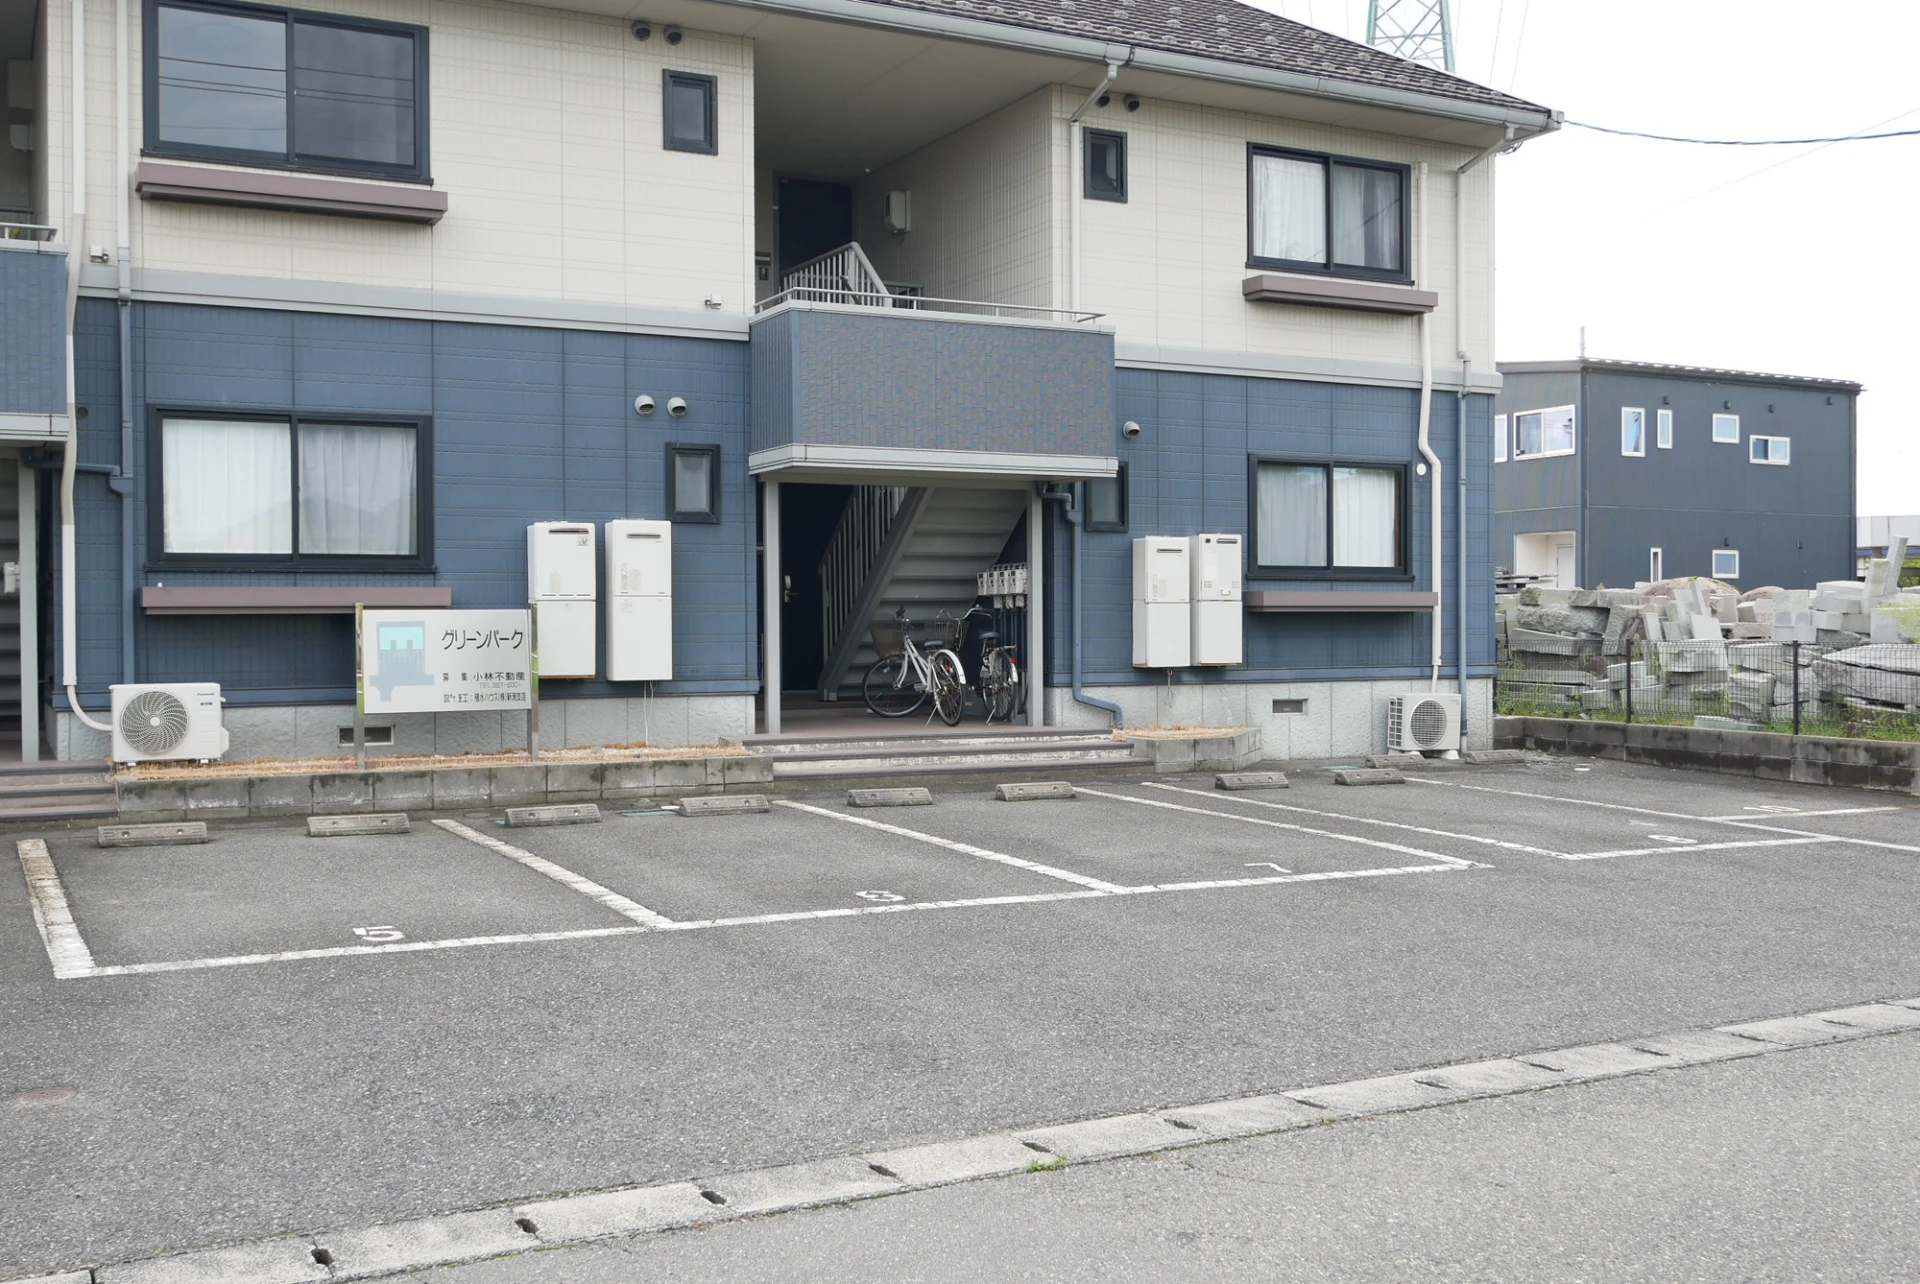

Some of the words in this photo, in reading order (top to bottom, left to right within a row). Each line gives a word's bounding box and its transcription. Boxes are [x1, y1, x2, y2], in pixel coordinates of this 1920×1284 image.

[441, 629, 523, 650] グリーンパーク
[352, 925, 405, 942] 5
